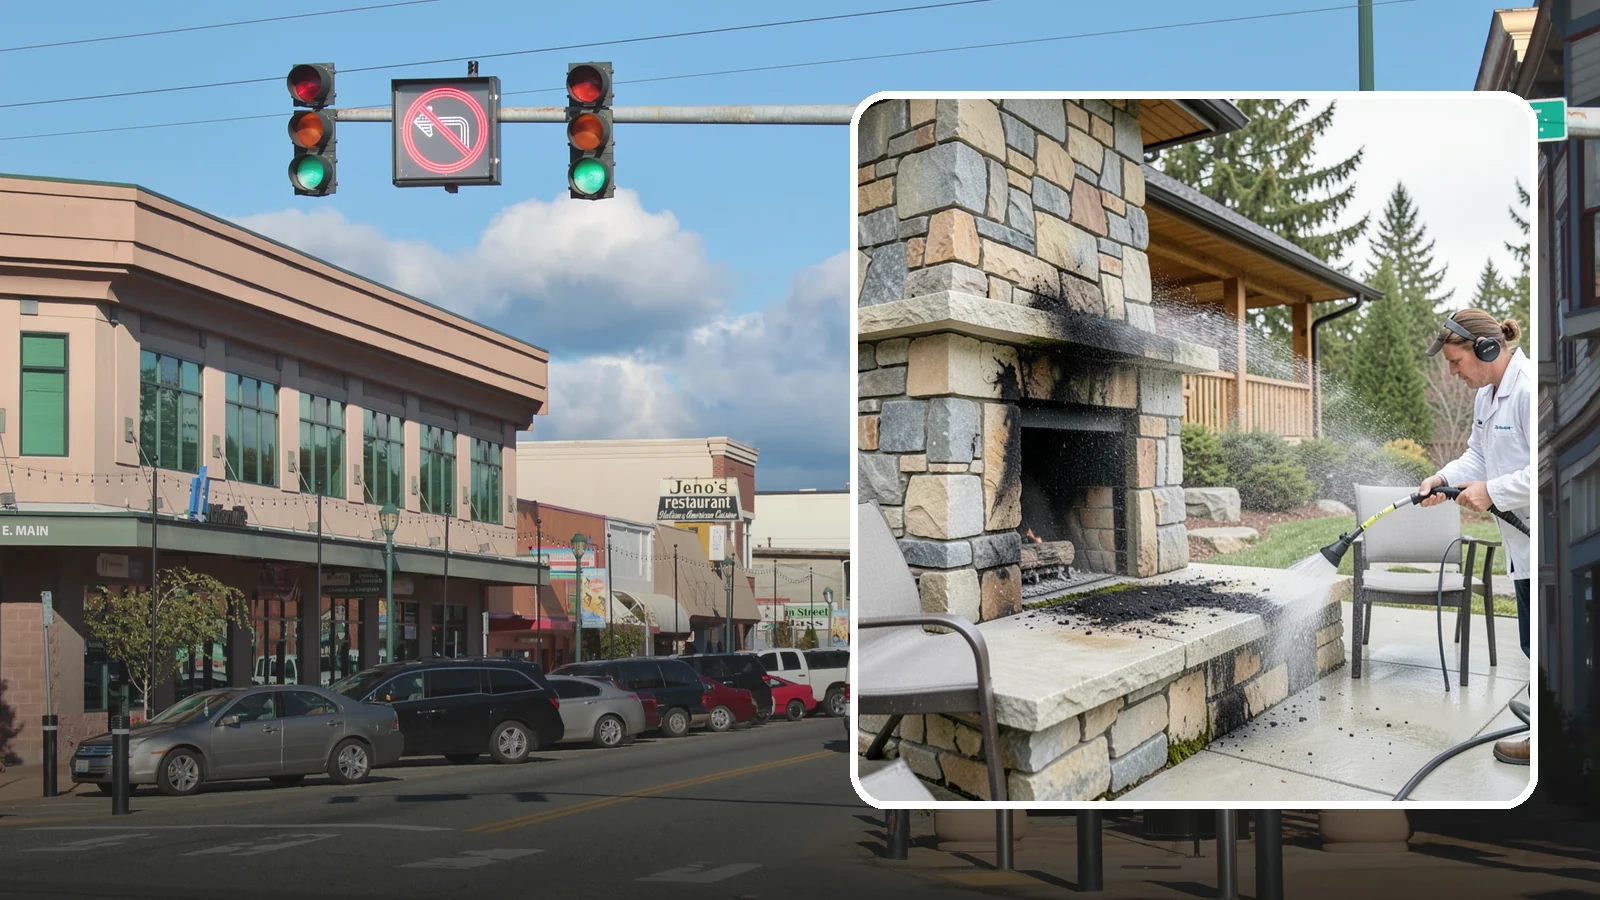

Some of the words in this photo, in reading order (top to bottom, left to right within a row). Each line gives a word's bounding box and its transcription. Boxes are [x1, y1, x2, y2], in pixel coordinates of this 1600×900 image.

[669, 480, 727, 495] Jeno's
[665, 496, 731, 509] restaurant
[658, 510, 681, 520] Italian
[686, 510, 714, 520] American
[715, 510, 737, 520] Cuisine
[2, 525, 13, 536] E.
[15, 525, 49, 536] MAIN
[797, 607, 828, 617] Street
